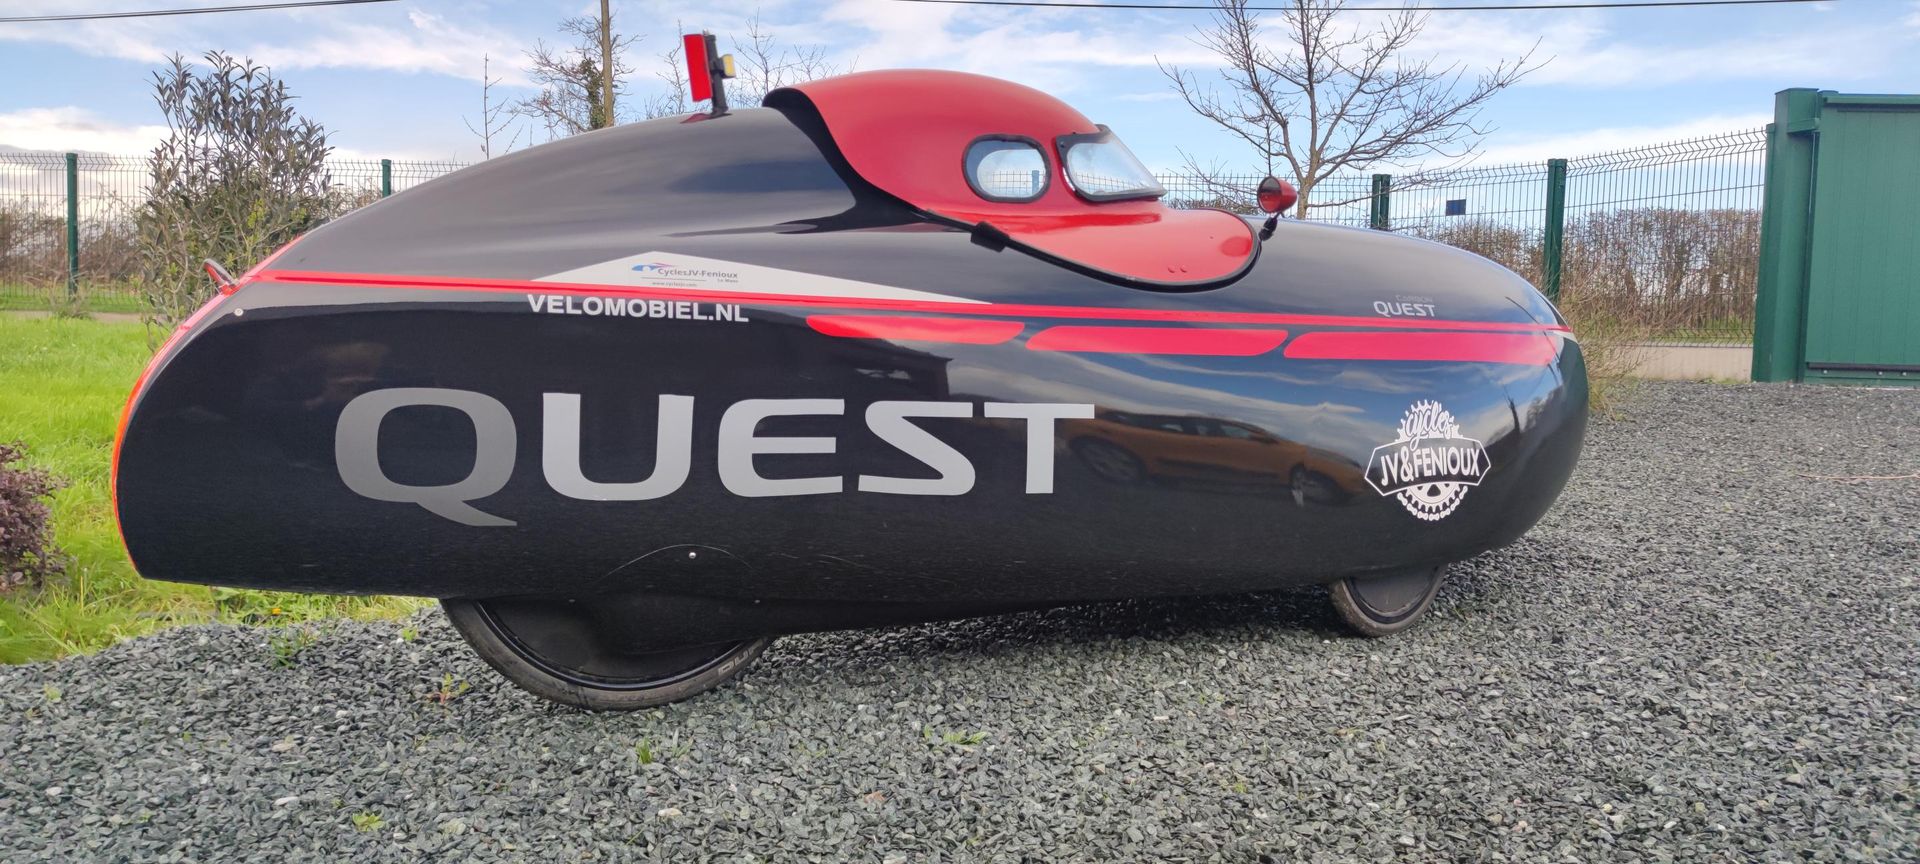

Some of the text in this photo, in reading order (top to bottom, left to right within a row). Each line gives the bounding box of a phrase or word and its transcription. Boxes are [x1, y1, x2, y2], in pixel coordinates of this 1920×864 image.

[527, 294, 749, 322] VELOMOBIEL.NL
[1373, 301, 1435, 317] QUEST
[335, 387, 1095, 527] QUEST
